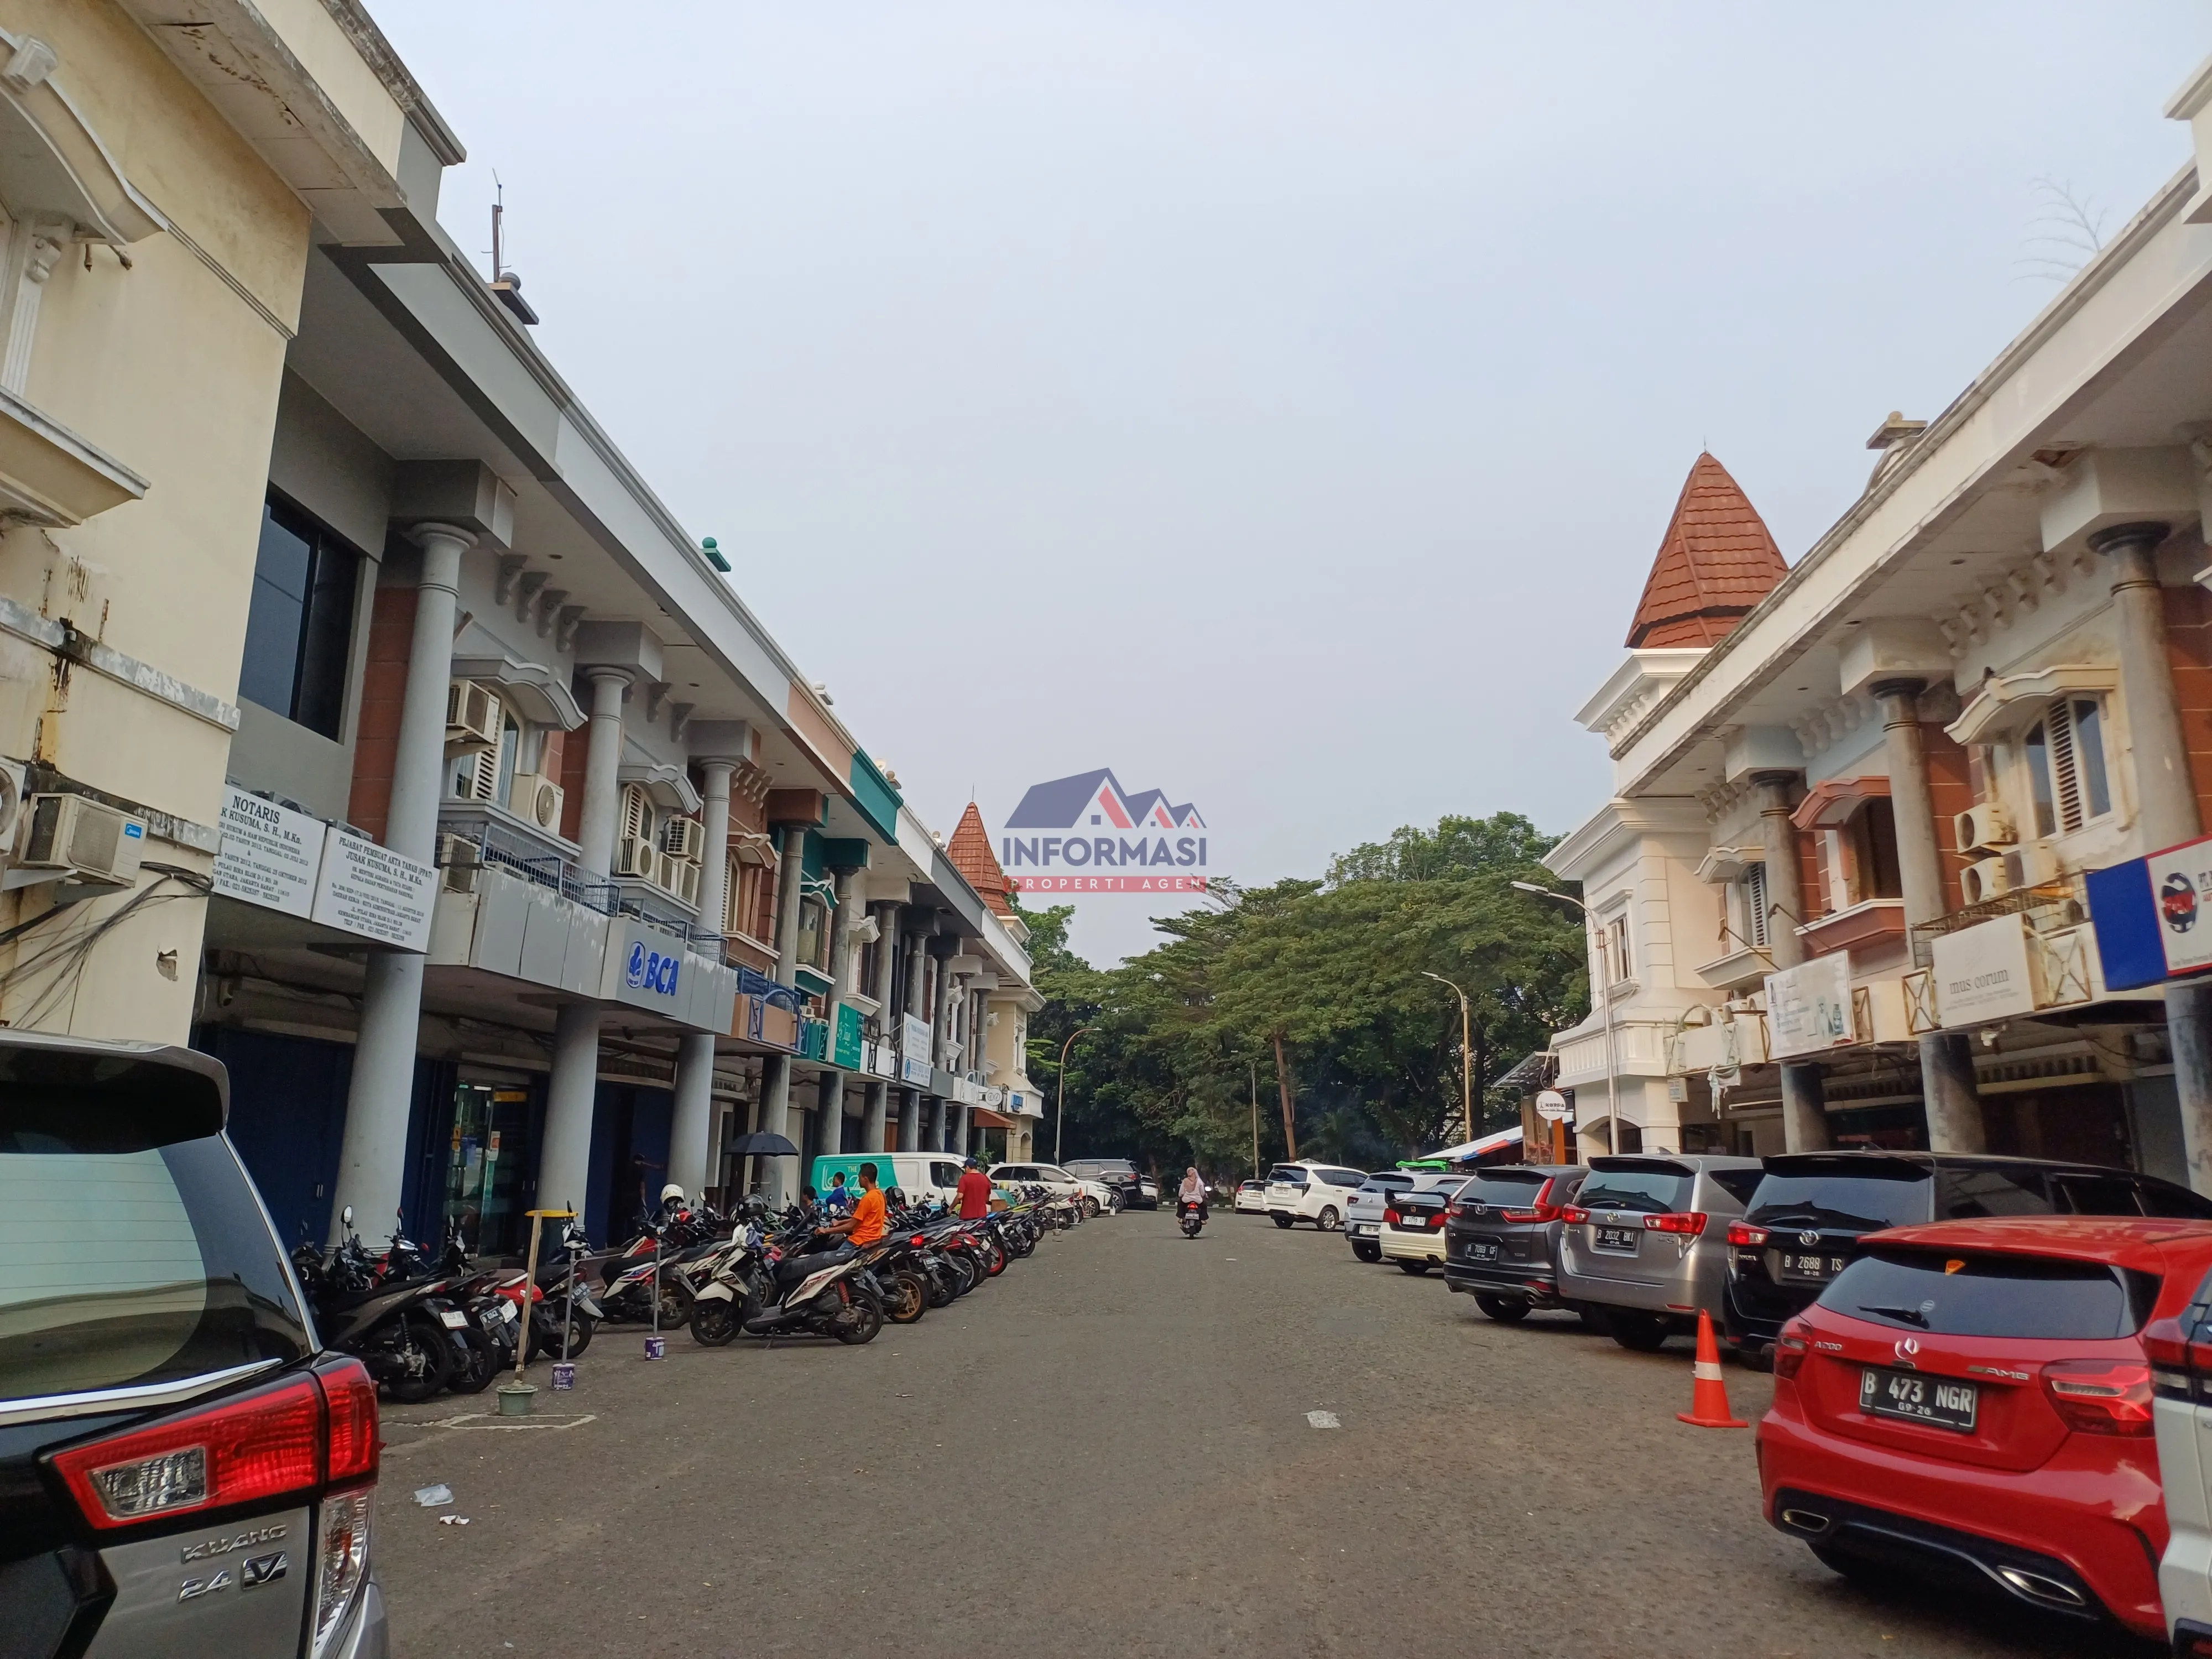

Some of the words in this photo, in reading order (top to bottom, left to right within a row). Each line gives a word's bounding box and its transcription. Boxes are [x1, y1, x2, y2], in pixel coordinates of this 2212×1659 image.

[232, 795, 280, 825] NOTARIS
[228, 810, 262, 831] KUSUMA,
[283, 830, 302, 845] M.Kn.
[338, 836, 362, 853] PEJABAT
[363, 846, 387, 862] PEMBUAT
[345, 850, 366, 865] JUSAK
[366, 858, 392, 875] KUSUMA,
[643, 952, 679, 996] BCA
[1949, 979, 1971, 994] mus
[1974, 969, 2009, 988] corum
[1598, 1229, 1602, 1238] B
[1785, 1255, 1791, 1267] B
[1797, 1256, 1821, 1270] 2688
[1831, 1258, 1842, 1271] TS
[1985, 1368, 2030, 1381] AMG
[1865, 1372, 1877, 1394] B
[1888, 1376, 1924, 1404] 473
[1936, 1384, 1973, 1413] NGR
